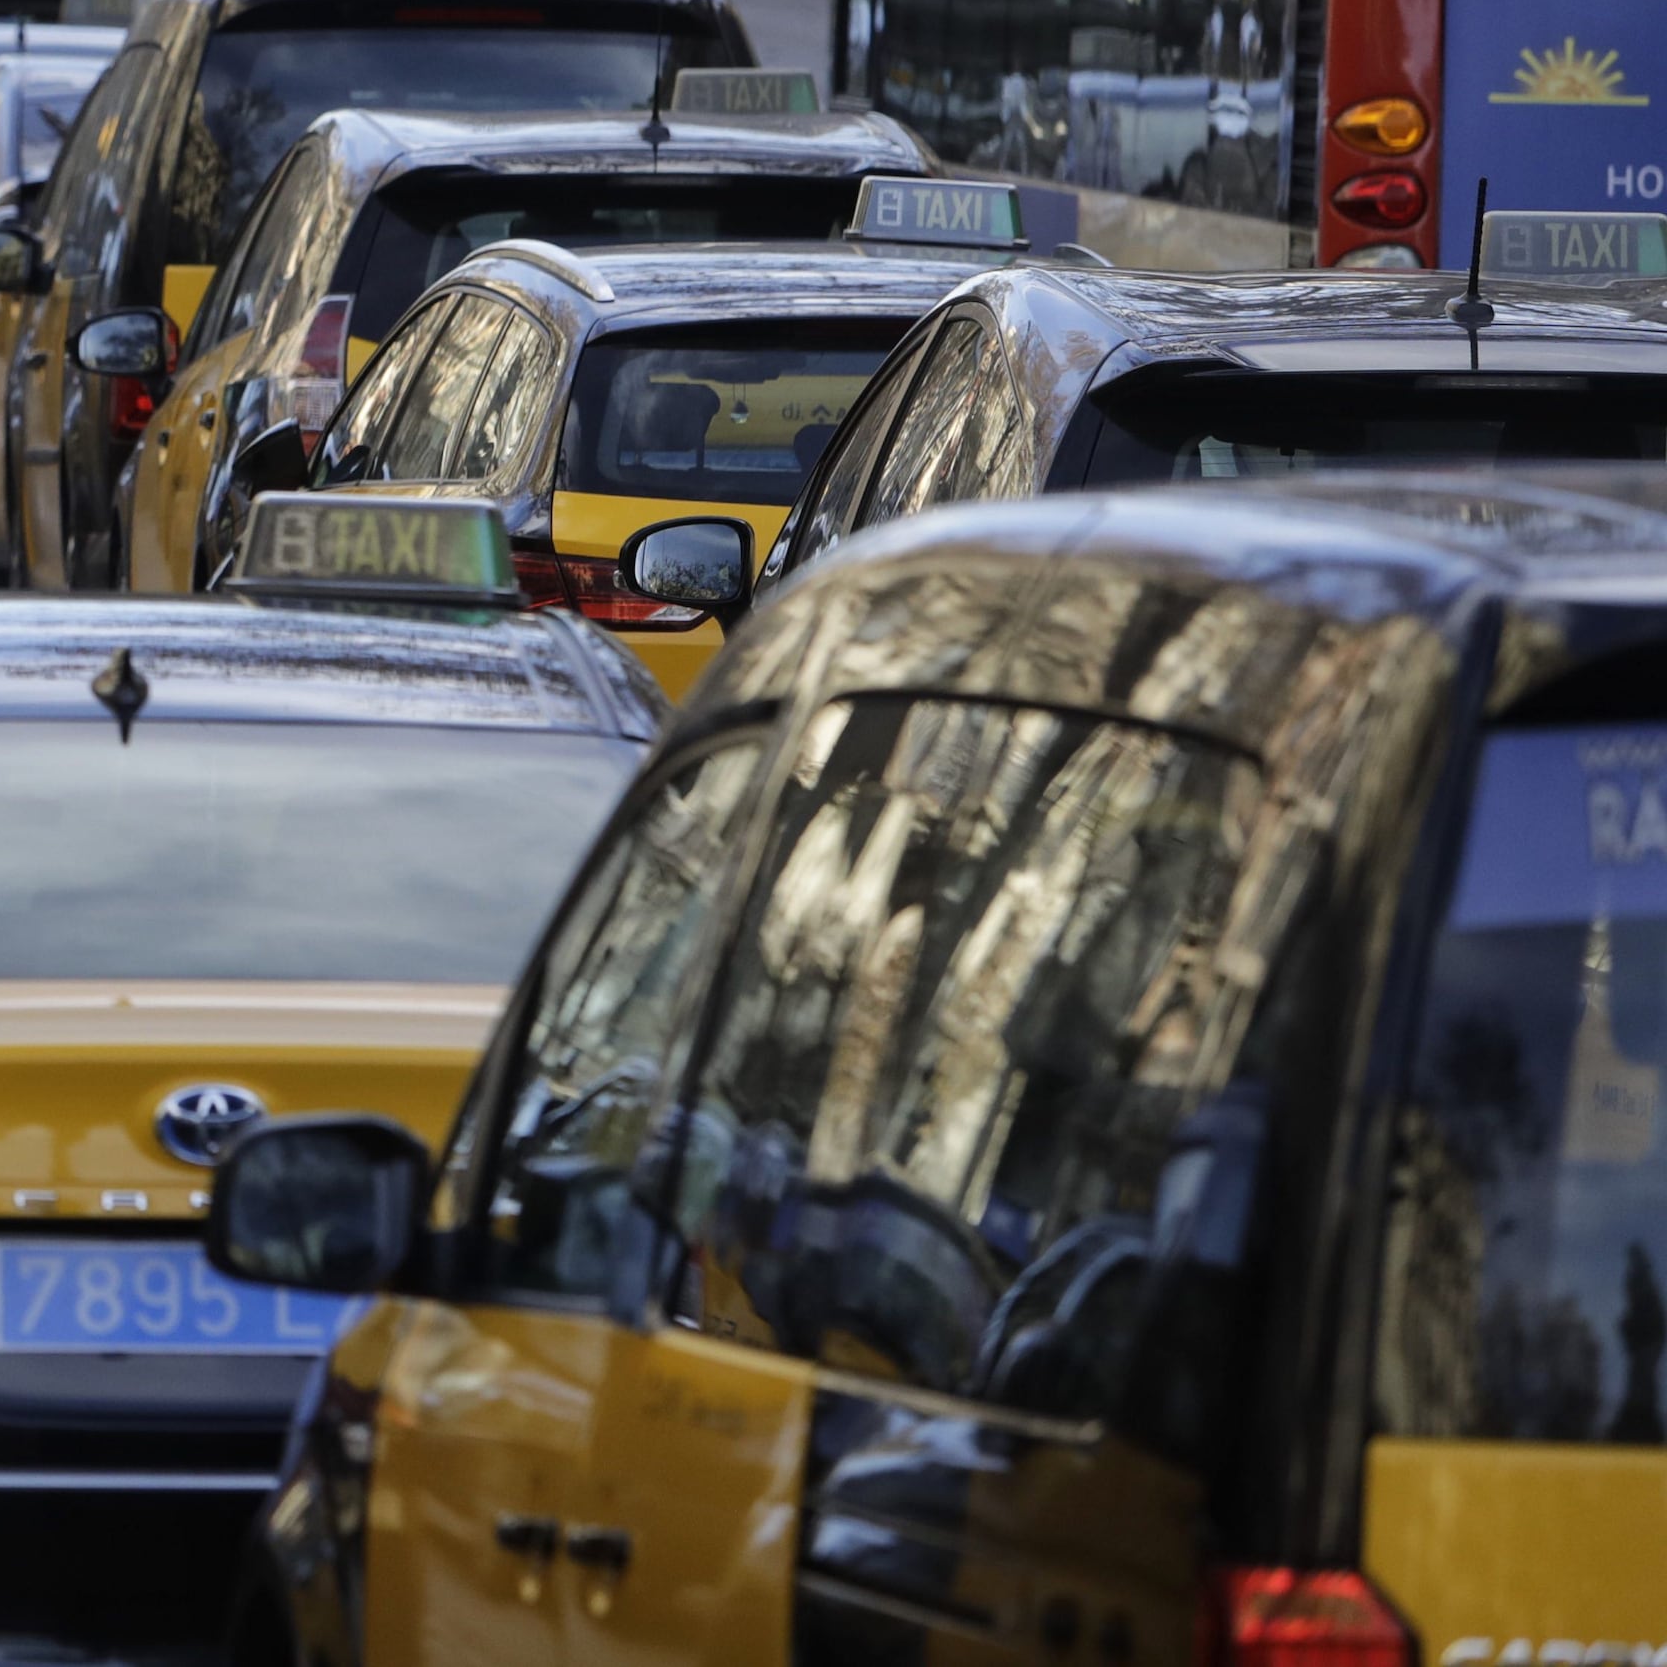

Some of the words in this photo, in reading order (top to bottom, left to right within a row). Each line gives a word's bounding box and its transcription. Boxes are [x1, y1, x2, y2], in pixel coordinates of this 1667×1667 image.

[912, 189, 983, 231] TAXI
[1544, 222, 1629, 268] TAXI
[327, 509, 439, 575] TAXI
[14, 1256, 241, 1337] 7895
